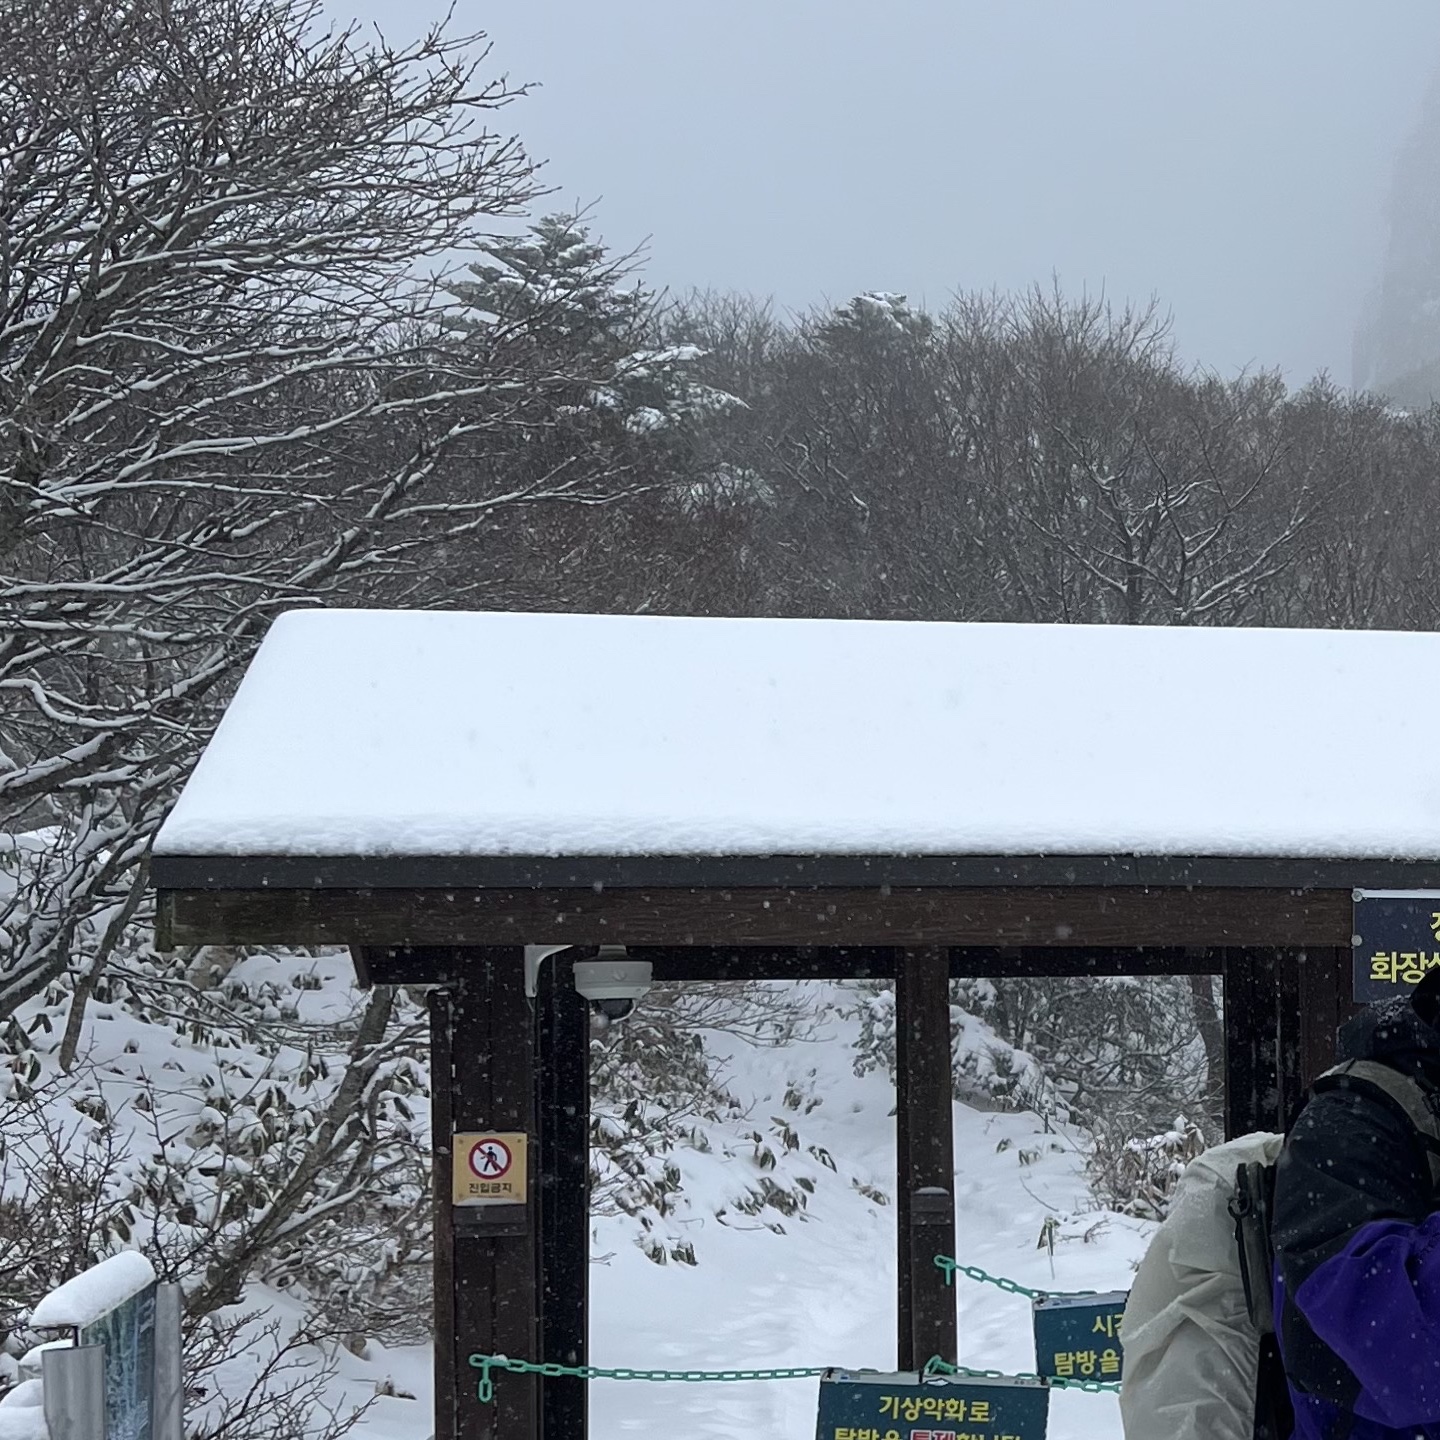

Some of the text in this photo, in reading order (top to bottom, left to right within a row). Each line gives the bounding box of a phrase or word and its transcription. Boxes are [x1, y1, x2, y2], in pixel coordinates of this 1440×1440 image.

[469, 1183, 512, 1194] 진입금지
[1054, 1348, 1120, 1376] 탐방을
[879, 1395, 991, 1423] 기상악화로
